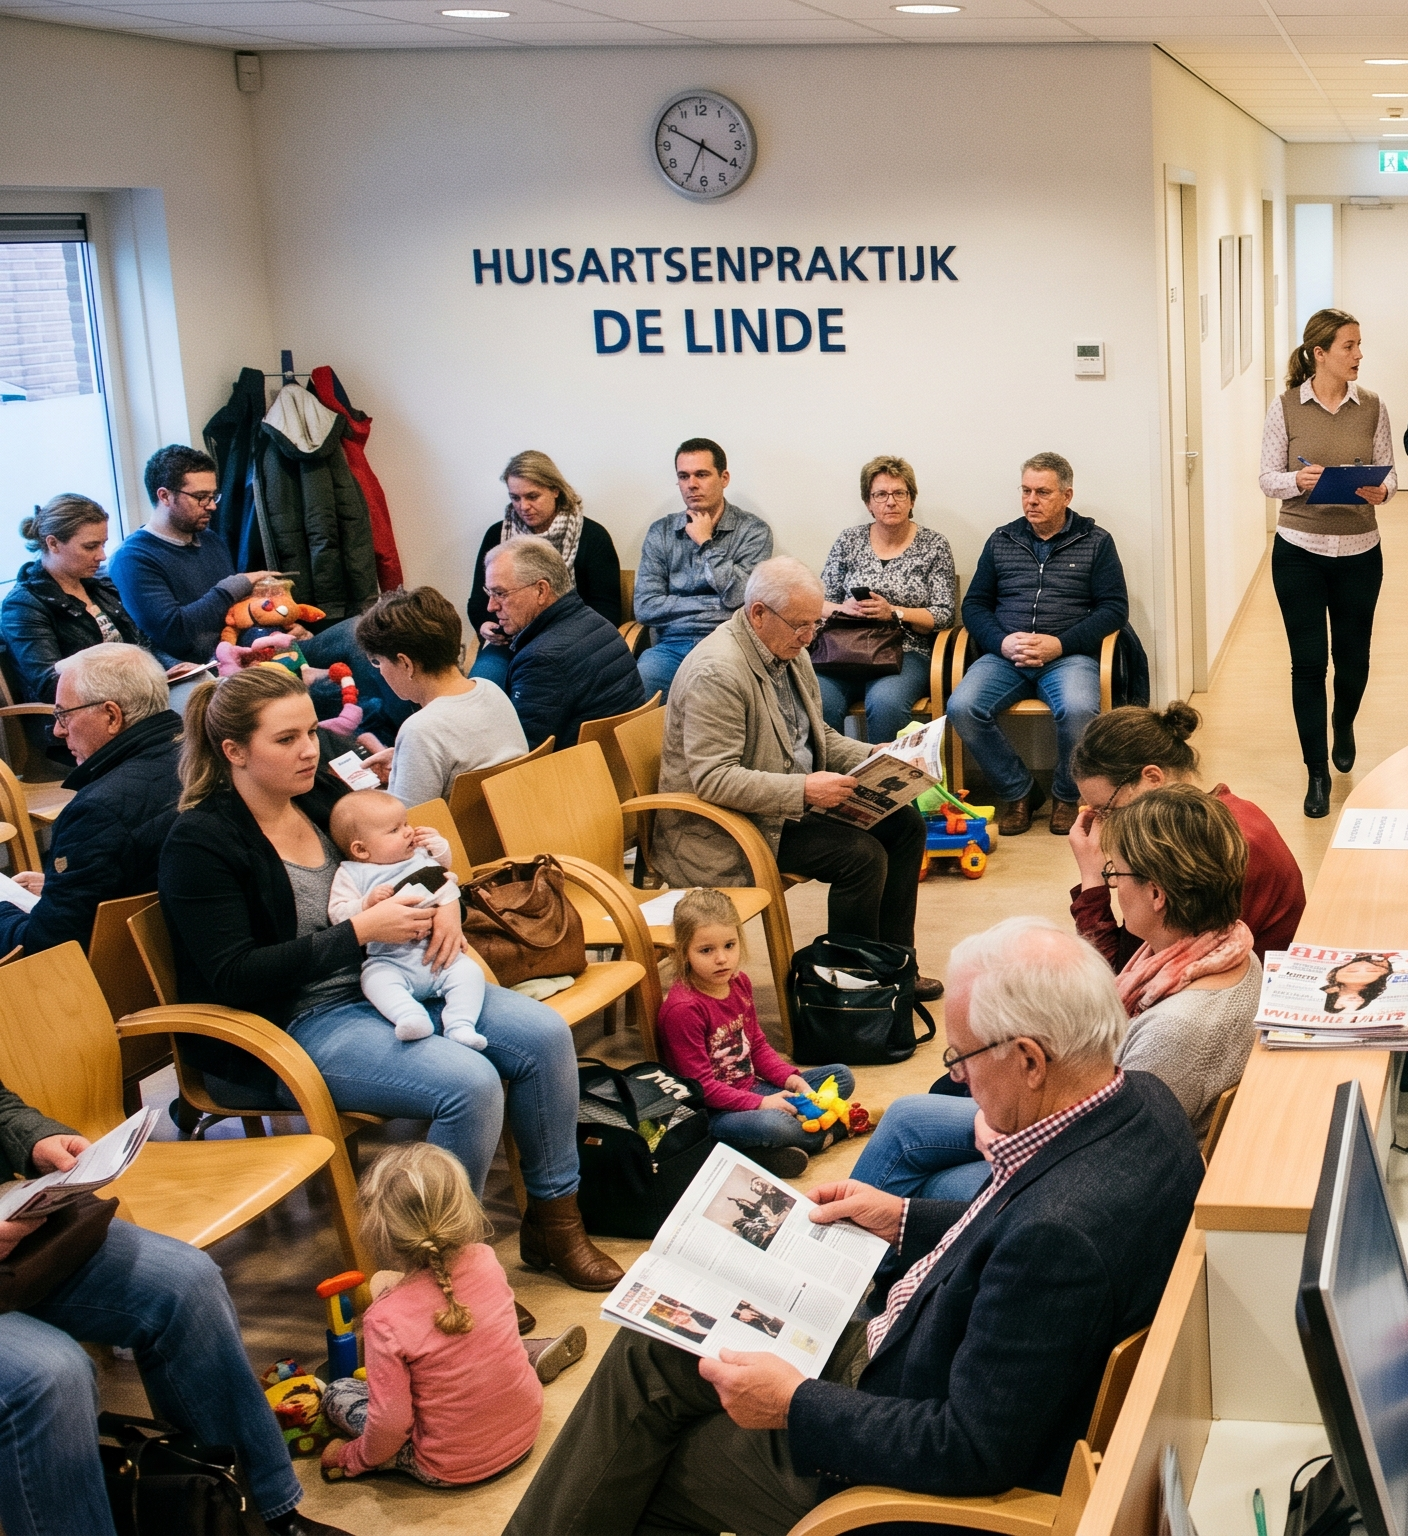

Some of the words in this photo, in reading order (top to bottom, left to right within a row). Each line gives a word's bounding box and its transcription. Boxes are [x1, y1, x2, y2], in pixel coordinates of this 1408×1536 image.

[681, 111, 687, 119] 11
[695, 105, 707, 116] 12
[717, 110, 721, 118] 1
[729, 123, 736, 133] 2
[663, 141, 671, 151] 9
[734, 140, 742, 151] 3
[669, 158, 677, 169] 8
[729, 158, 738, 168] 4
[683, 173, 690, 182] 7
[700, 176, 708, 187] 6
[719, 173, 726, 182] 5
[472, 245, 959, 285] HUISARTSENPRAKTIJK
[593, 309, 665, 354] DE
[684, 308, 846, 354] LINDE
